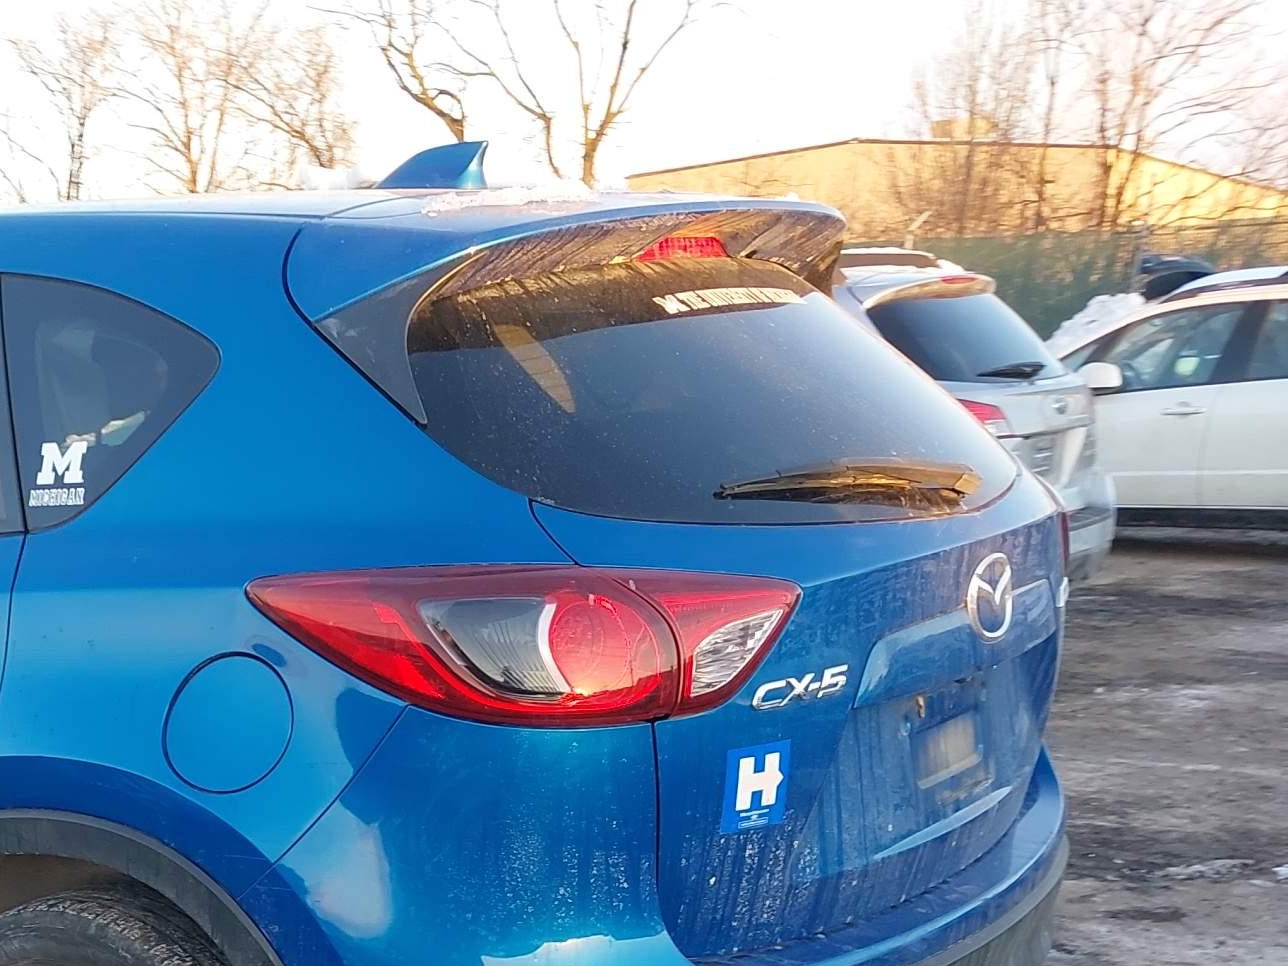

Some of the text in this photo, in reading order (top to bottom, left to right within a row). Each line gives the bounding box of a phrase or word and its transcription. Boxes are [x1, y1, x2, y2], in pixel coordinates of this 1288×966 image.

[36, 440, 88, 485] M
[751, 663, 849, 710] CX-5
[735, 751, 784, 812] H
